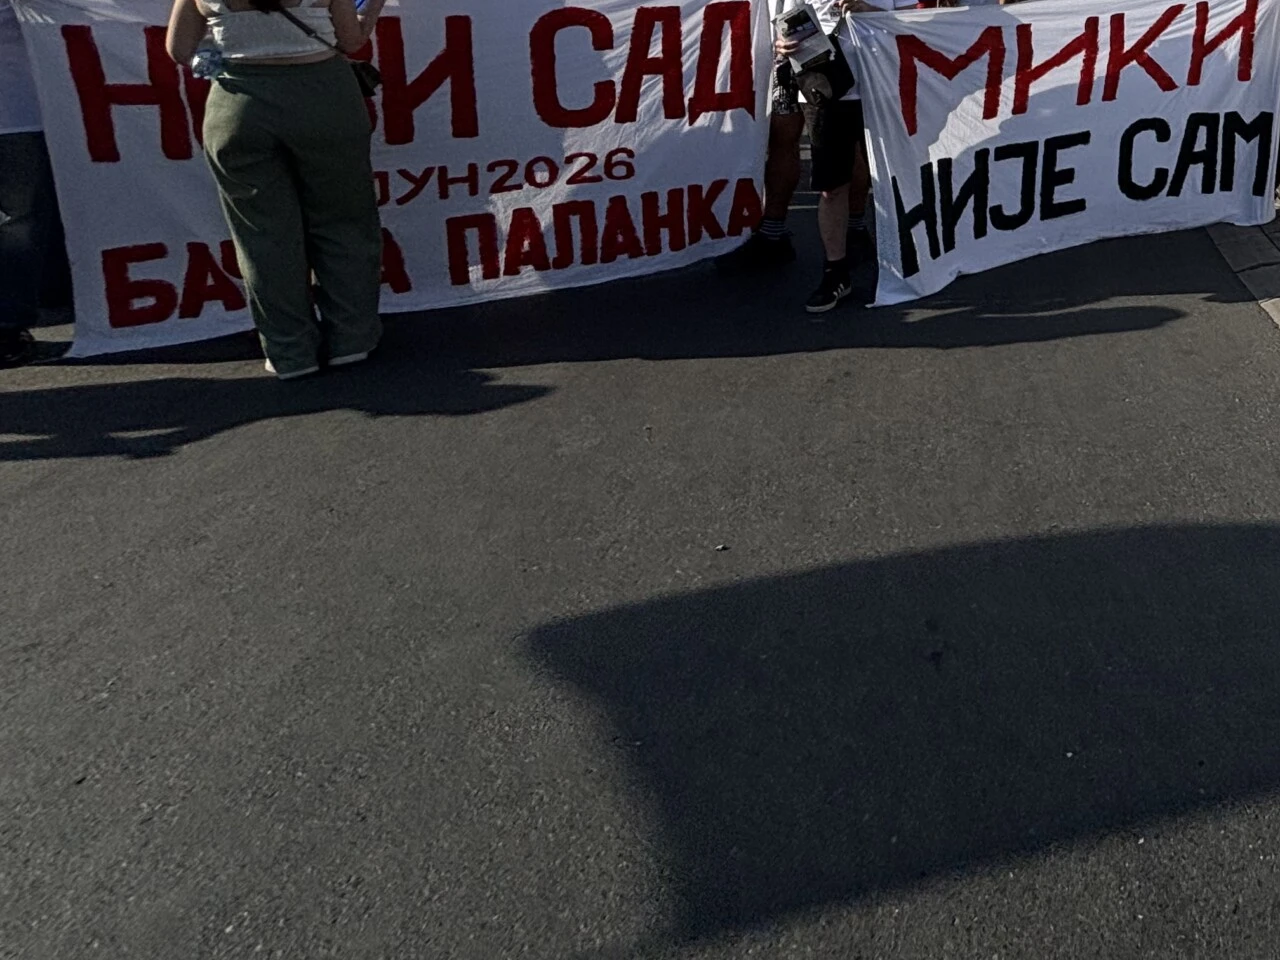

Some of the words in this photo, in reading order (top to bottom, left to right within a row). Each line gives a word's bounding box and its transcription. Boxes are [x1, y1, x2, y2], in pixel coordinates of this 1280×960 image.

[61, 15, 479, 163] НИ
[529, 0, 756, 128] САД
[446, 178, 763, 286] ПАЛАНКА
[891, 130, 1091, 278] НИЈЕ
[1118, 111, 1273, 201] САМ
